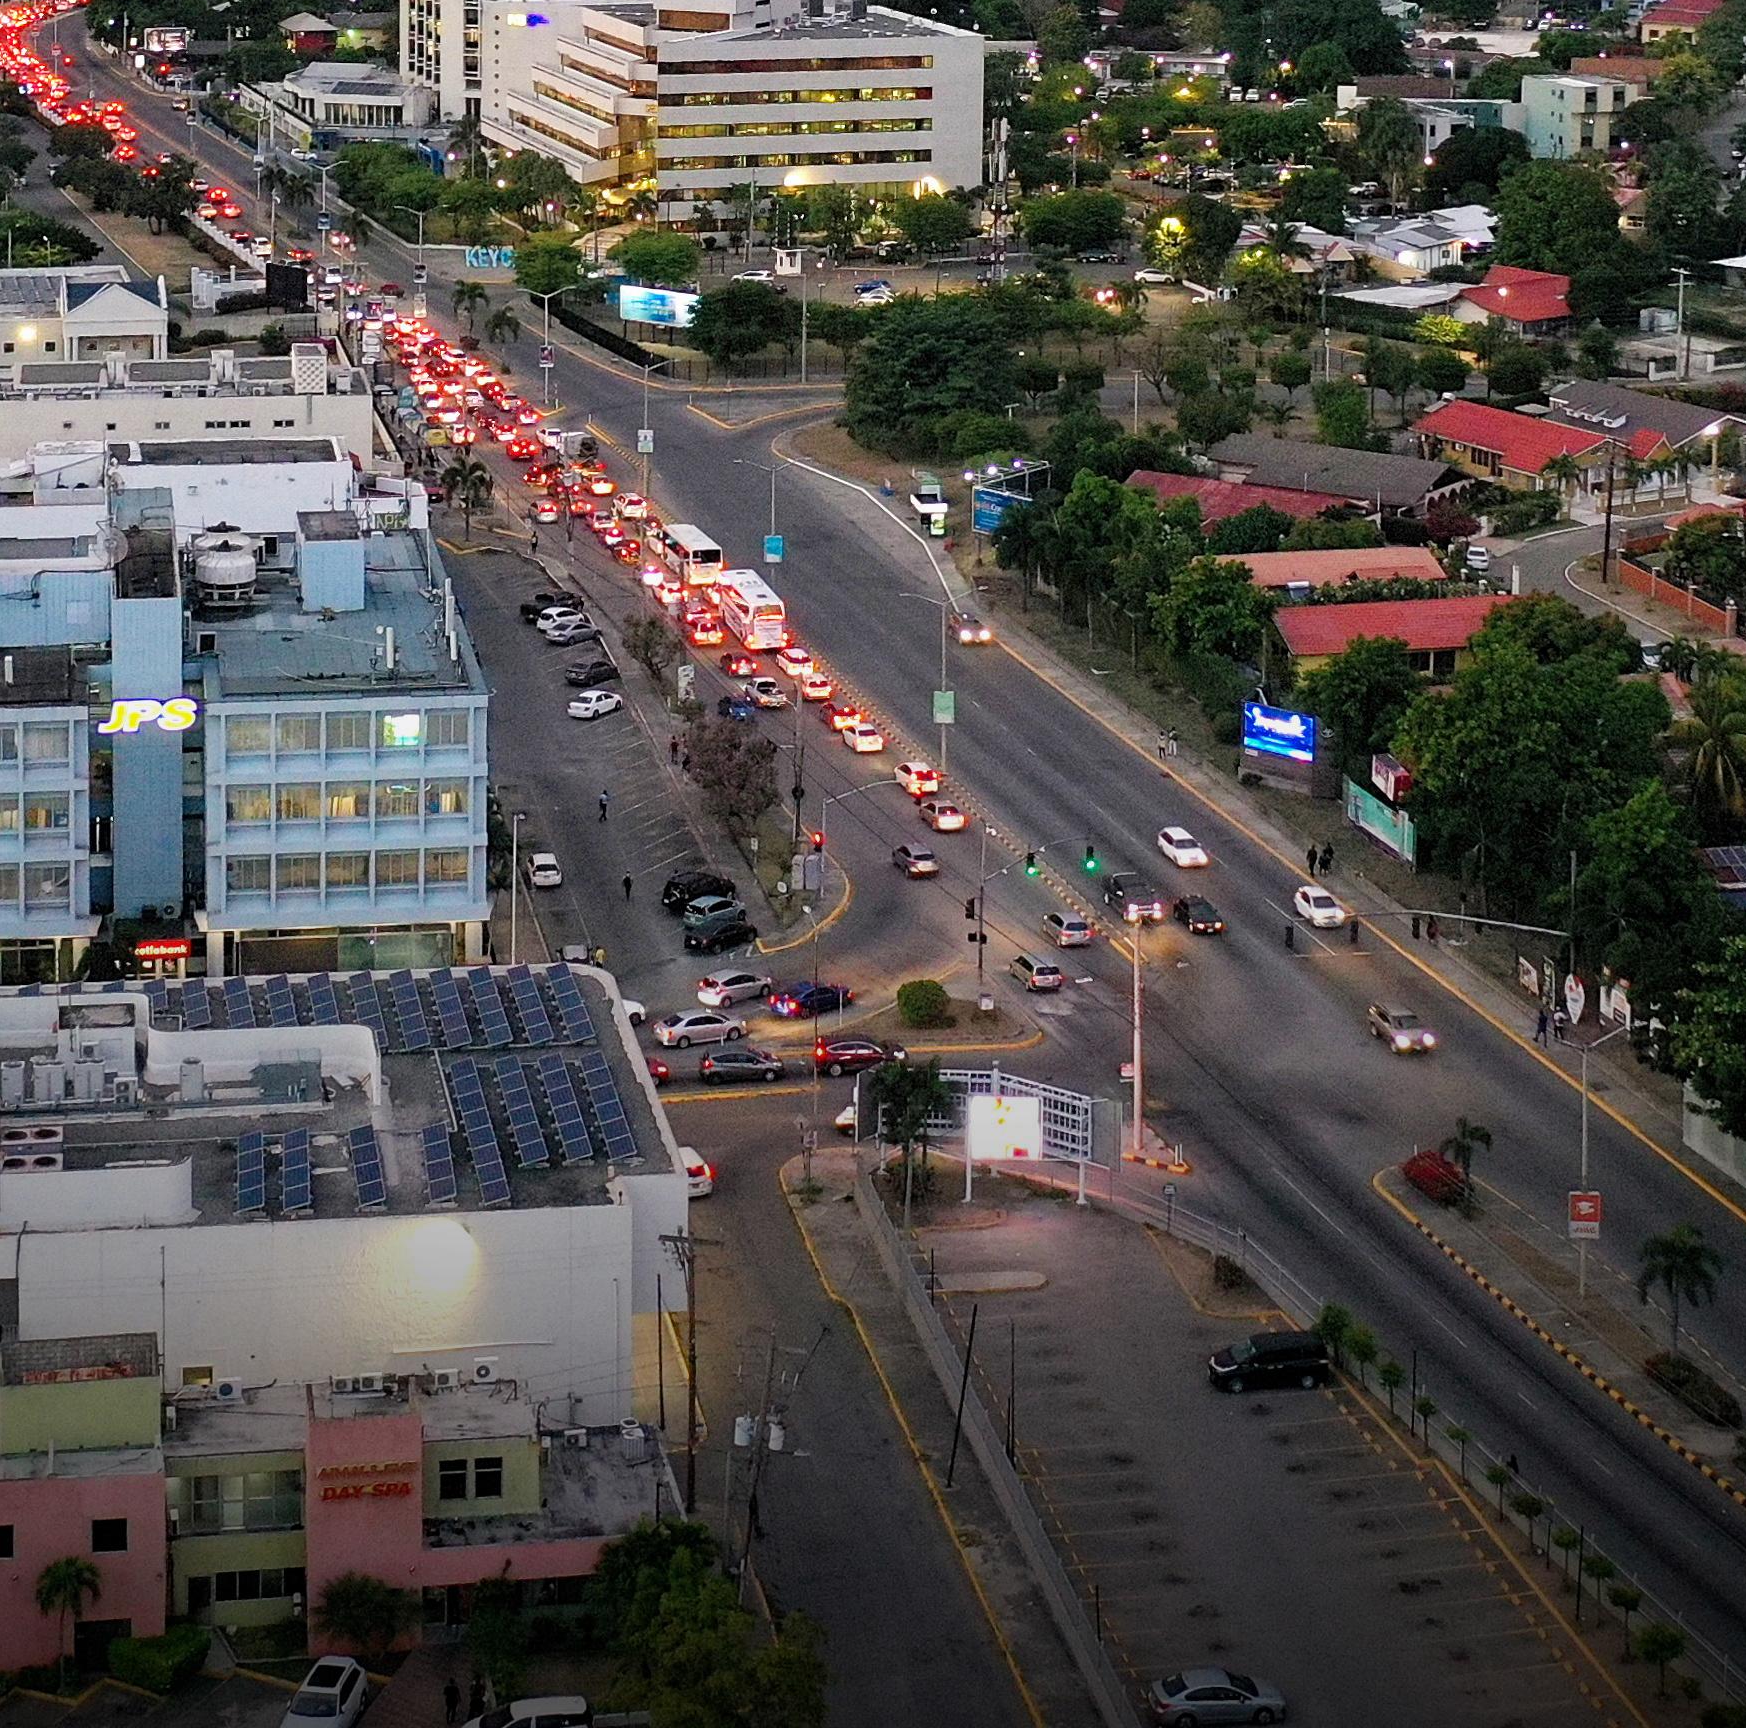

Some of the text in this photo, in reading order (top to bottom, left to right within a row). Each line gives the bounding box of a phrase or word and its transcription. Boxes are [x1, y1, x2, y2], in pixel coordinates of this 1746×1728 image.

[465, 246, 516, 268] KEYC
[97, 698, 198, 734] JPS
[134, 944, 188, 956] cotiabank
[321, 1481, 412, 1501] DAY SPA
